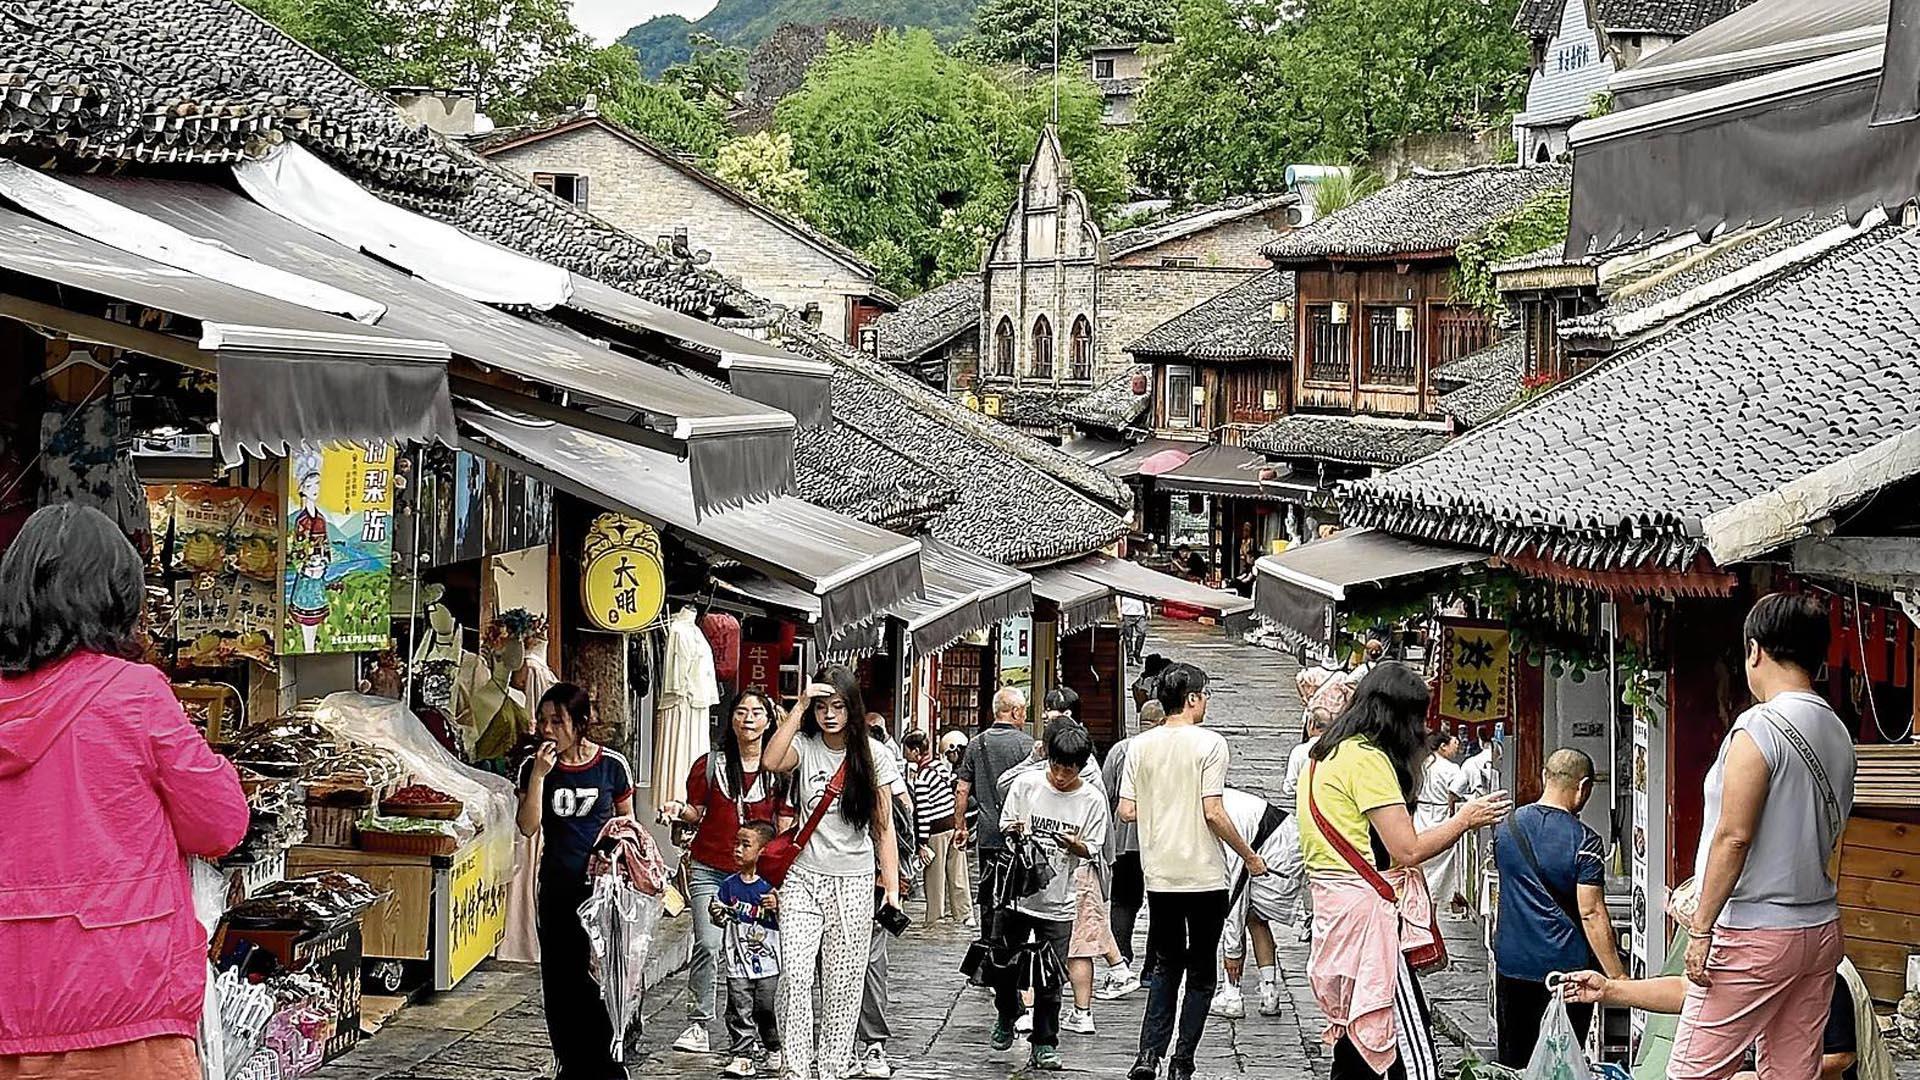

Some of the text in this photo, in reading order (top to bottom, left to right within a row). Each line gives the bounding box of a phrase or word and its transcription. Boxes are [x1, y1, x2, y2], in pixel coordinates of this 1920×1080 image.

[613, 556, 640, 614] 大明
[1454, 635, 1495, 714] 冰粉
[552, 788, 599, 817] 07
[1031, 814, 1061, 831] WARN
